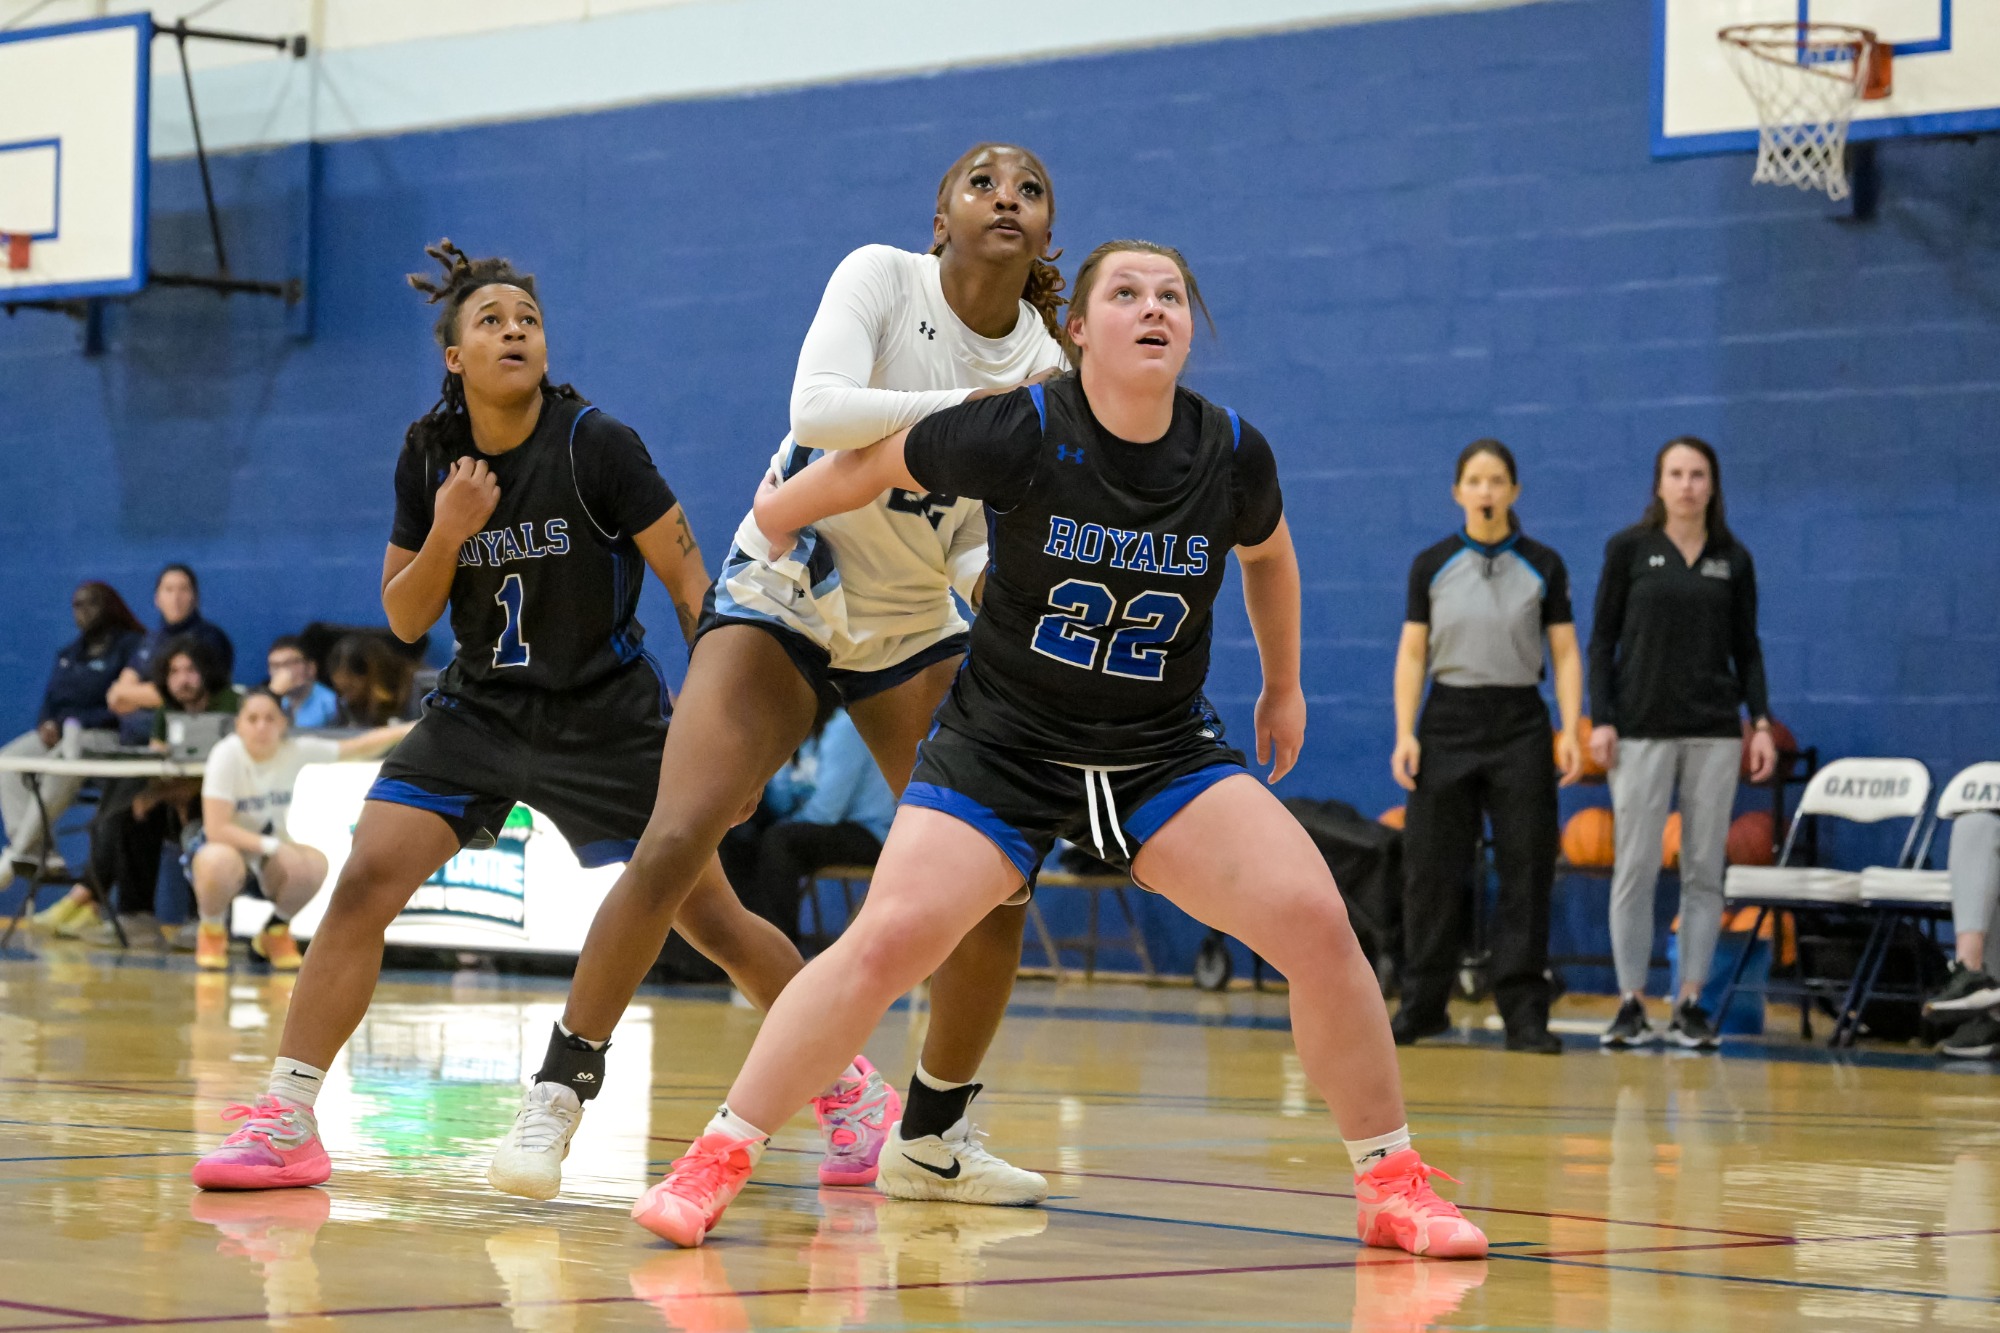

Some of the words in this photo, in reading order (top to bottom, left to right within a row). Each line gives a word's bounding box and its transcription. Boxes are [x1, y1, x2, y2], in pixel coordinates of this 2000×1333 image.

[458, 518, 570, 567] OYALS
[1043, 515, 1209, 576] ROYALS
[492, 573, 529, 669] 1
[1030, 578, 1190, 681] 22
[1824, 776, 1912, 799] GATORS
